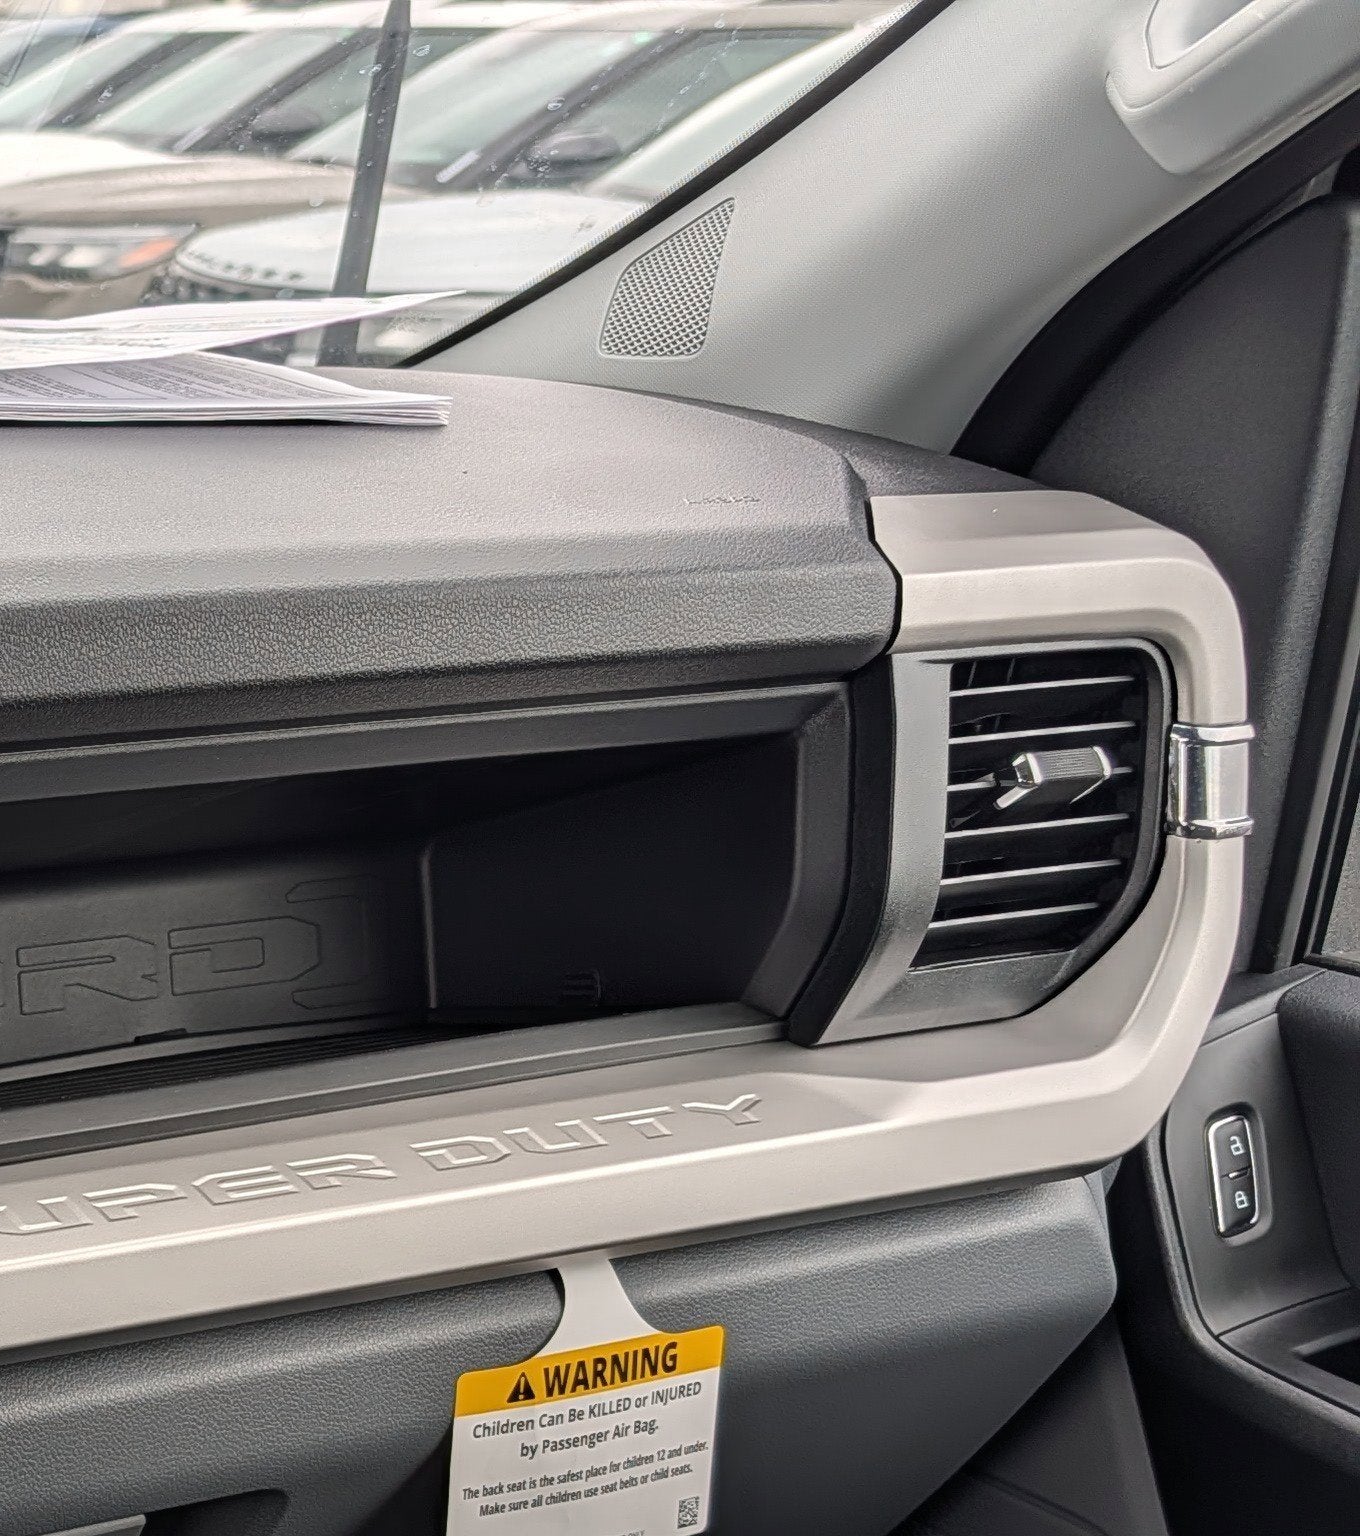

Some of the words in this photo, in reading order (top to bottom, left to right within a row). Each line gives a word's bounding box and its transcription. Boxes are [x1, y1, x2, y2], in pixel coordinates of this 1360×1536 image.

[409, 1093, 763, 1172] DUTY
[543, 1341, 678, 1398] WARNING
[473, 1416, 534, 1439] Children
[539, 1413, 564, 1430] Can
[568, 1407, 585, 1424] Be
[588, 1397, 631, 1421] KILLED
[635, 1396, 647, 1408] or
[651, 1381, 702, 1406] INJURED
[520, 1441, 537, 1460] by
[542, 1430, 608, 1456] Passenger
[612, 1423, 630, 1440] Air
[634, 1416, 658, 1437] Bag.
[463, 1487, 480, 1500] The
[482, 1483, 505, 1498] back
[507, 1480, 526, 1494] seat
[529, 1477, 537, 1489] is
[540, 1475, 555, 1488] the
[557, 1470, 583, 1485] safest
[585, 1464, 607, 1482] place
[609, 1460, 620, 1473] for
[623, 1453, 654, 1471] children
[657, 1450, 666, 1461] 12
[667, 1445, 682, 1460] and
[479, 1502, 506, 1517] Make
[508, 1499, 529, 1512] sure
[531, 1495, 543, 1508] all
[545, 1490, 582, 1506] children
[584, 1486, 599, 1498] use
[600, 1481, 618, 1495] seat
[619, 1475, 638, 1491] belts
[640, 1474, 649, 1485] or
[651, 1467, 669, 1483] child
